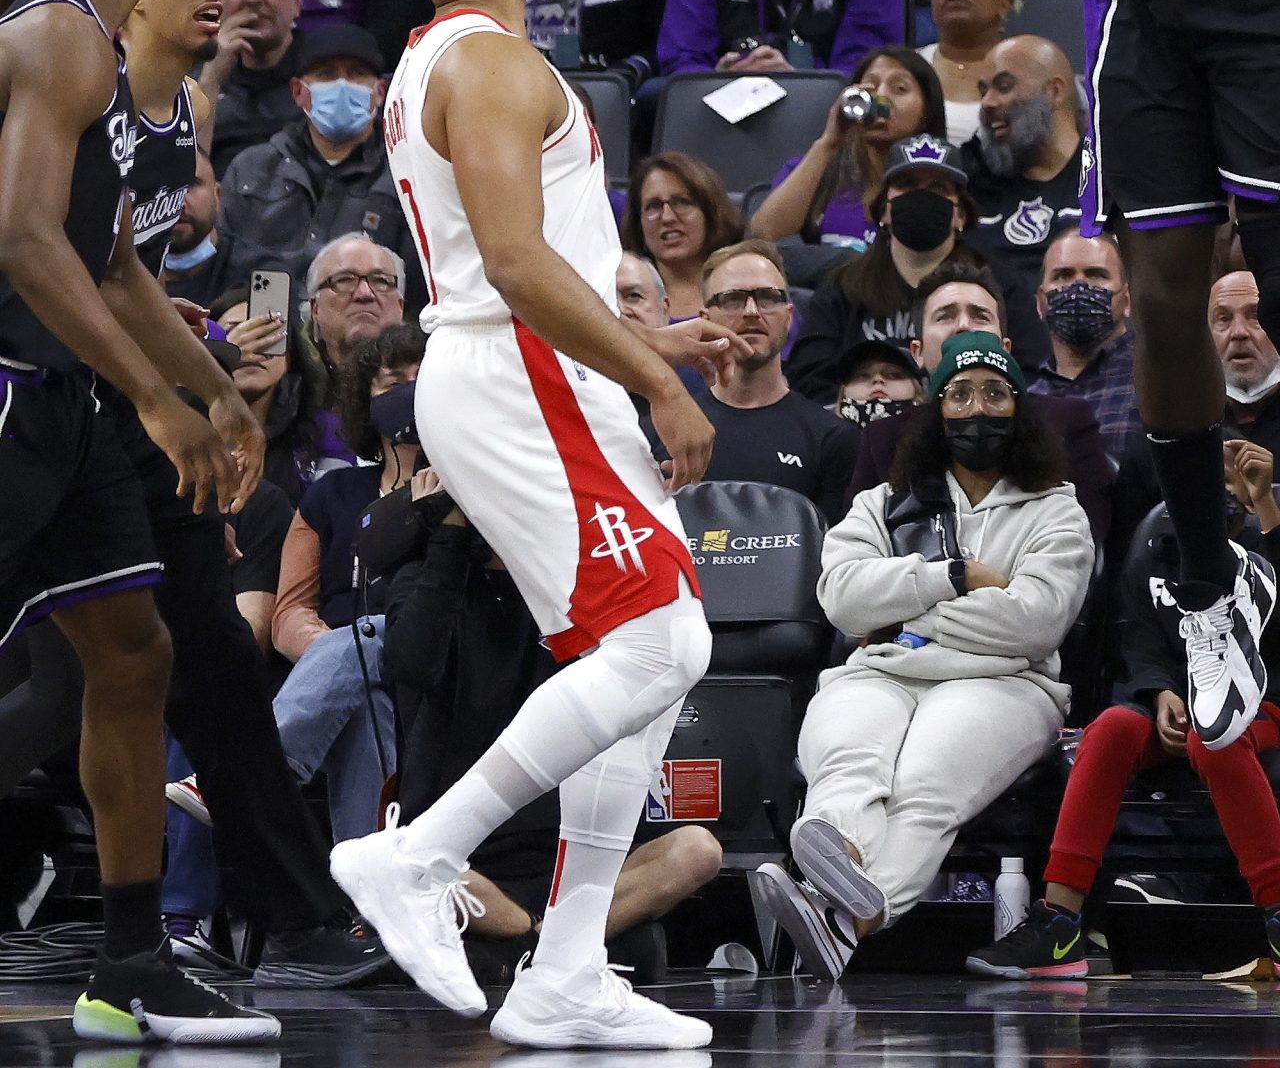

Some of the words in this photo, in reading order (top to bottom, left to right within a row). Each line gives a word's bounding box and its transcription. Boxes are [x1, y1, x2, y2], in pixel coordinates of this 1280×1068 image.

[955, 350, 984, 362] SOUL
[987, 350, 1009, 365] NOT
[956, 355, 980, 369] FOR
[983, 356, 1009, 373] SALE
[730, 533, 800, 550] CREEK
[712, 555, 759, 565] RESORT
